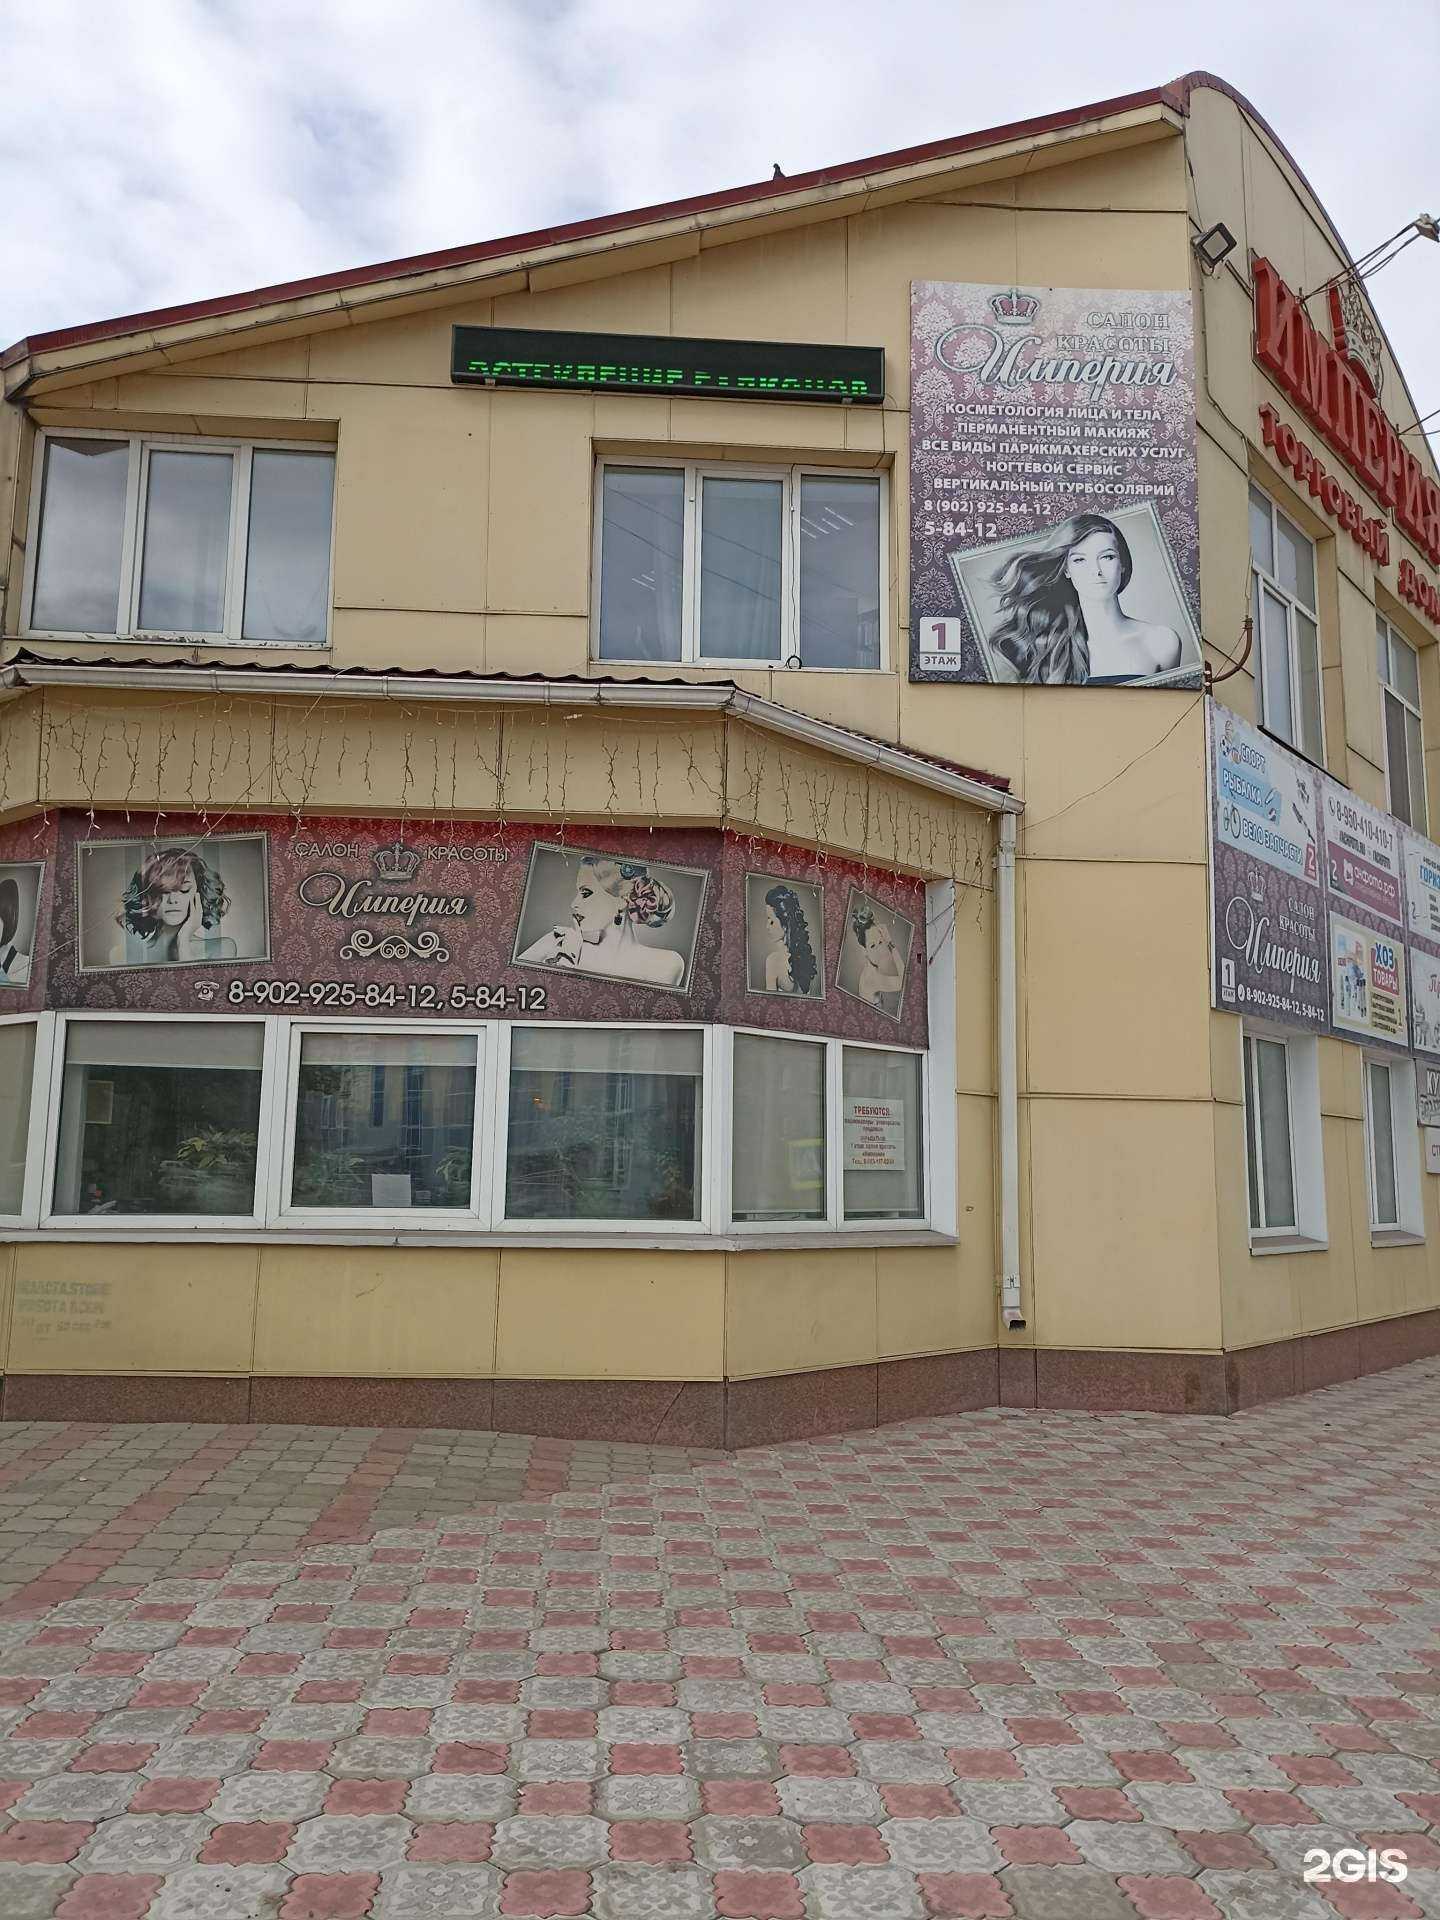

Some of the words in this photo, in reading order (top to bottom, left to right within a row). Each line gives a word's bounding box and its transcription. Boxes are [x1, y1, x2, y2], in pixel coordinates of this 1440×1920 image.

[1086, 311, 1170, 330] САЛОН
[1056, 335, 1172, 354] КРАСОТЫ
[935, 323, 1177, 401] Империя
[945, 403, 1064, 418] КОСМЕТОЛОГИЯ
[1066, 407, 1108, 421] ЛИЦА
[1111, 409, 1122, 420] И
[1125, 409, 1162, 421] ТЕЛА
[957, 422, 1081, 437] ПЕРМАНЕНТНЫЙ
[1084, 426, 1151, 439] МАКИЯЖ
[922, 440, 949, 451] ВСЕ
[952, 441, 996, 454] ВИДЫ
[999, 442, 1138, 458] ПАРИКМАХЕРСКИХ
[1141, 446, 1186, 458] УСЛУГ
[986, 461, 1064, 474] НОГТЕВОЙ
[1066, 463, 1122, 476] СЕРВИС
[934, 478, 1055, 492] ВЕРТИКАЛЬНЫЙ
[1058, 482, 1175, 496] ТУРБОСОЛЯРИЙ
[923, 499, 934, 511] 8
[936, 499, 974, 514] (902)
[977, 502, 1052, 515] 925-84-12
[924, 521, 998, 538] 5-84-12
[931, 622, 946, 650] 1
[924, 655, 957, 665] ЭТАЖ
[1223, 768, 1262, 806] РЫБАЛКА
[295, 842, 359, 858] САЛОН
[426, 845, 509, 862] КРАСОТЫ
[299, 872, 468, 926] Империя
[1288, 897, 1315, 921] САЛОН
[1279, 914, 1317, 942] КРАСОТЫ
[1225, 896, 1321, 993] Империя
[1374, 942, 1395, 970] ХОЗ
[1225, 963, 1231, 986] 1
[228, 980, 443, 1009] 8-902-925-84-12,
[450, 985, 547, 1010] 5-84-12
